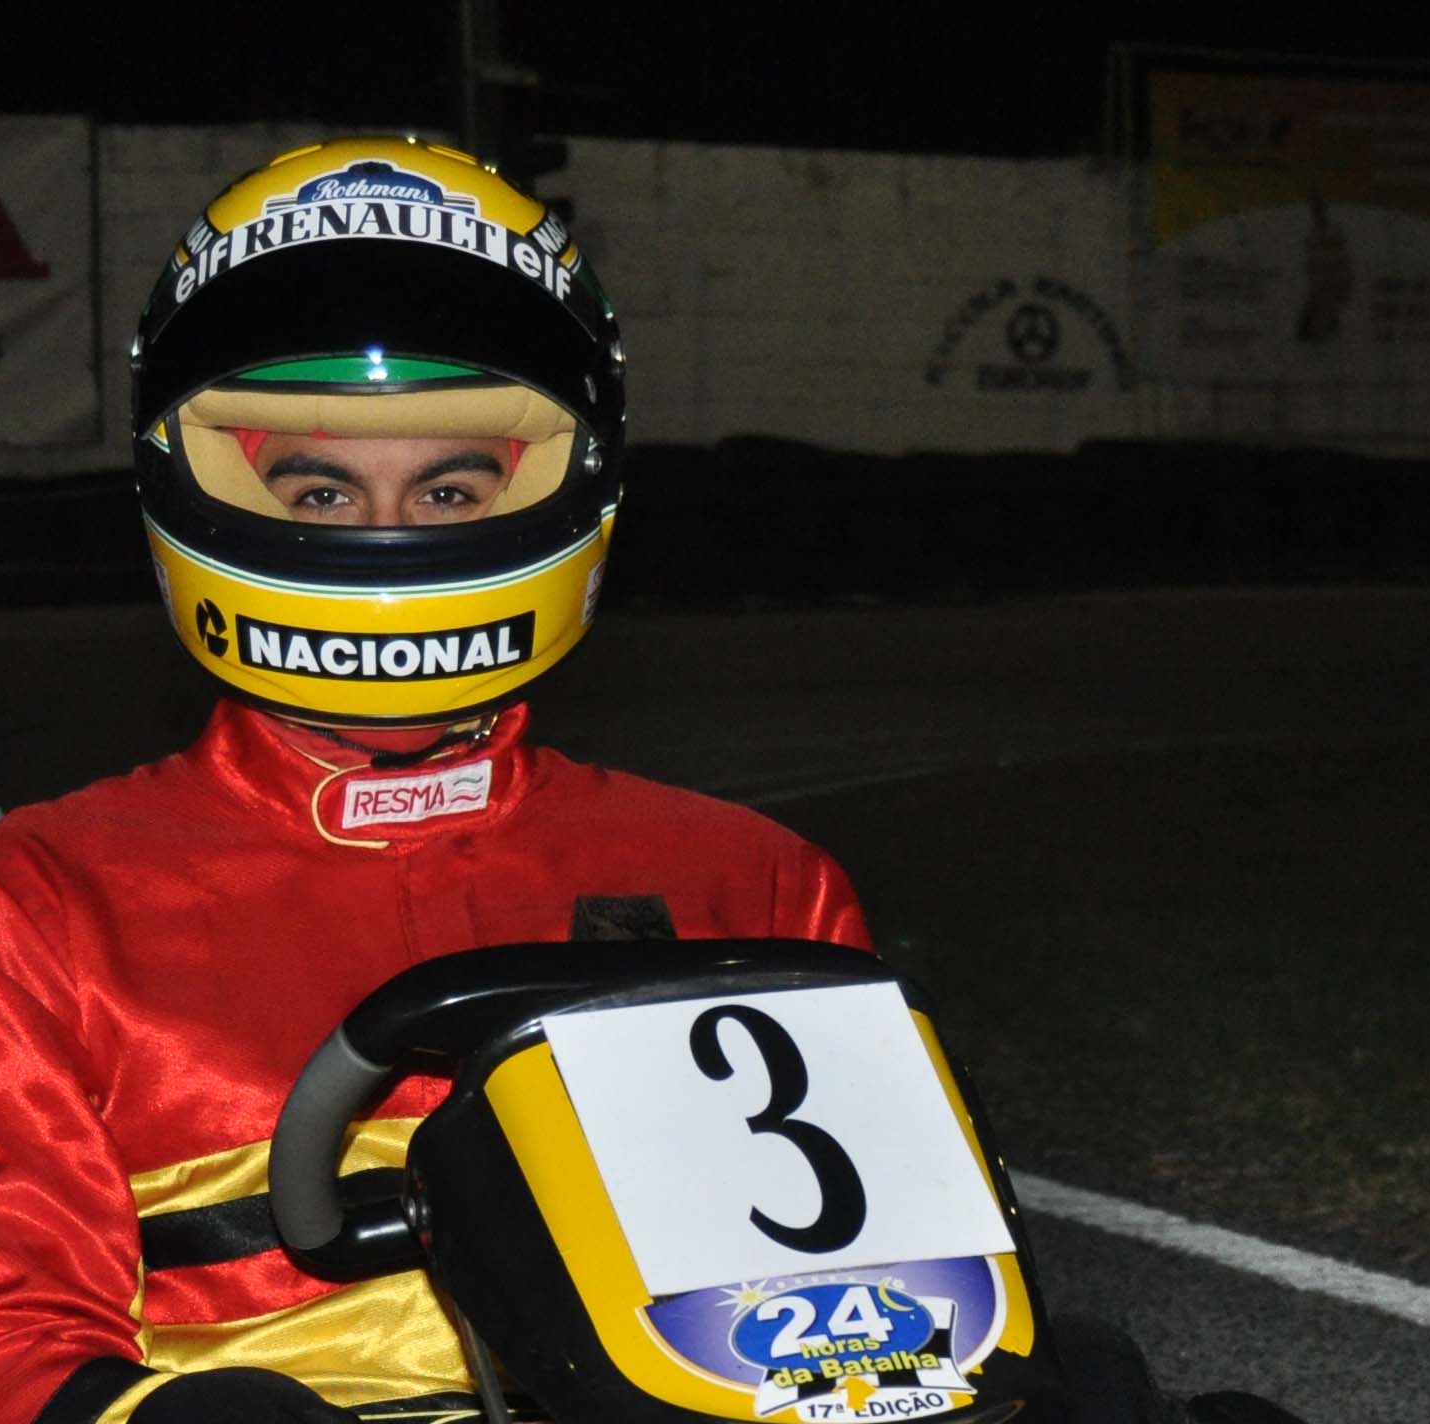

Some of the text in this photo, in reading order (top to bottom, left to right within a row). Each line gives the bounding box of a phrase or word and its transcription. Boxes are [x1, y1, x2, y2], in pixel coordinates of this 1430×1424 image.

[312, 178, 433, 203] Rothmans
[242, 201, 497, 259] RENAULT
[175, 236, 229, 303] elf
[514, 242, 571, 300] elf
[248, 625, 520, 677] NACIONAL
[352, 781, 447, 817] RESMA
[689, 1004, 867, 1255] 3
[756, 1285, 893, 1359] 24
[800, 1337, 881, 1360] horas
[773, 1350, 941, 1389] da Batalha
